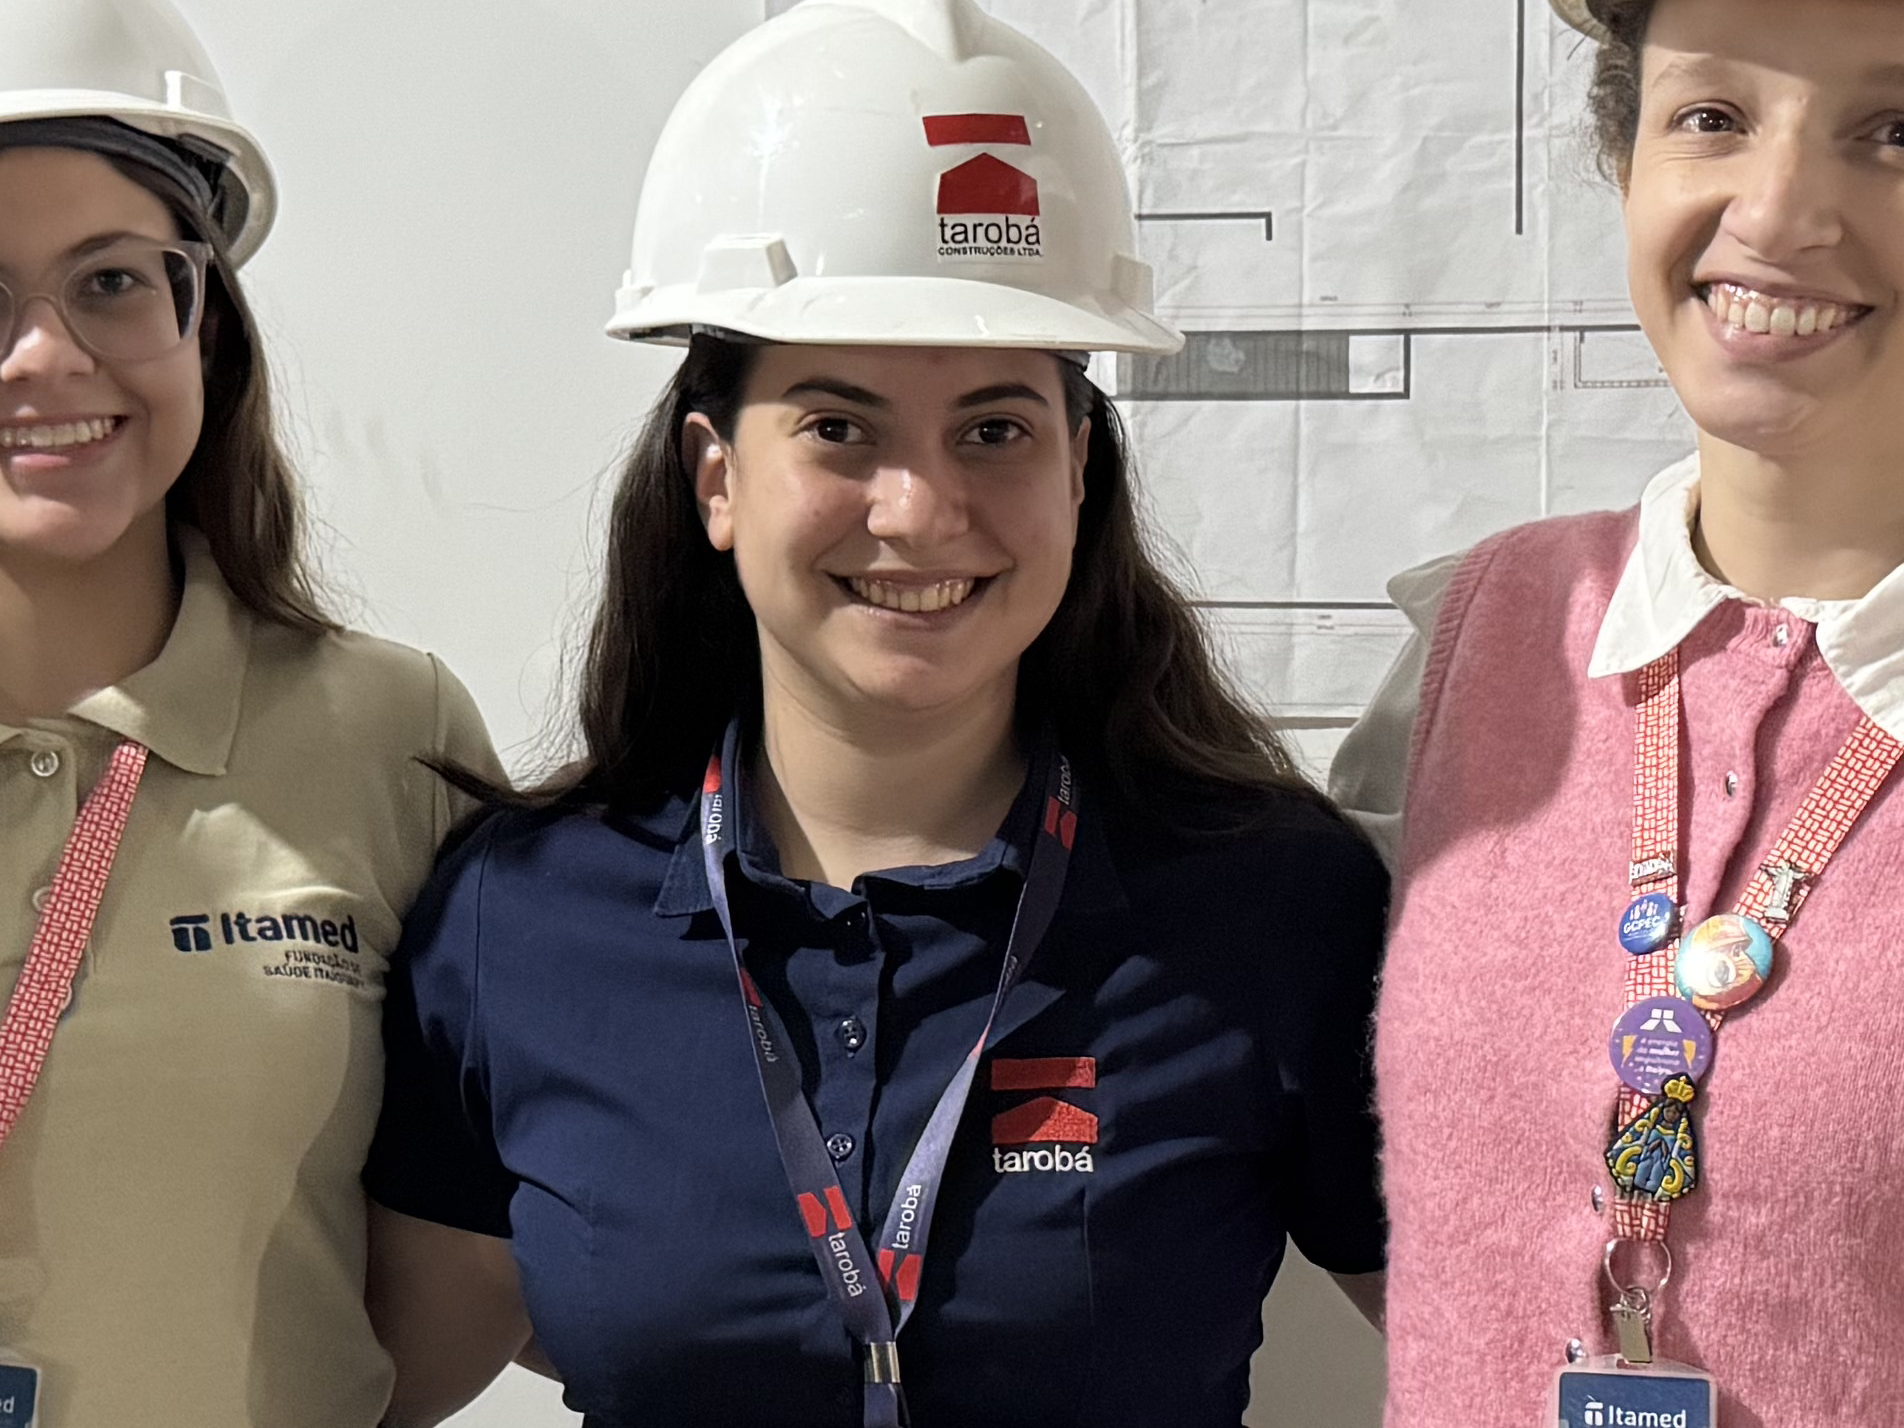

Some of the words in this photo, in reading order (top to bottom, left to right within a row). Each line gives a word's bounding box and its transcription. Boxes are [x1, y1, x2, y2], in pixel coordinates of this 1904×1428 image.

[938, 215, 1041, 246] tarobá
[937, 245, 1015, 257] CONSTRUÇÕES
[220, 911, 360, 954] Itamed
[991, 1145, 1094, 1173] tarobá
[891, 1184, 922, 1250] tarobá
[828, 1232, 867, 1297] tarobá
